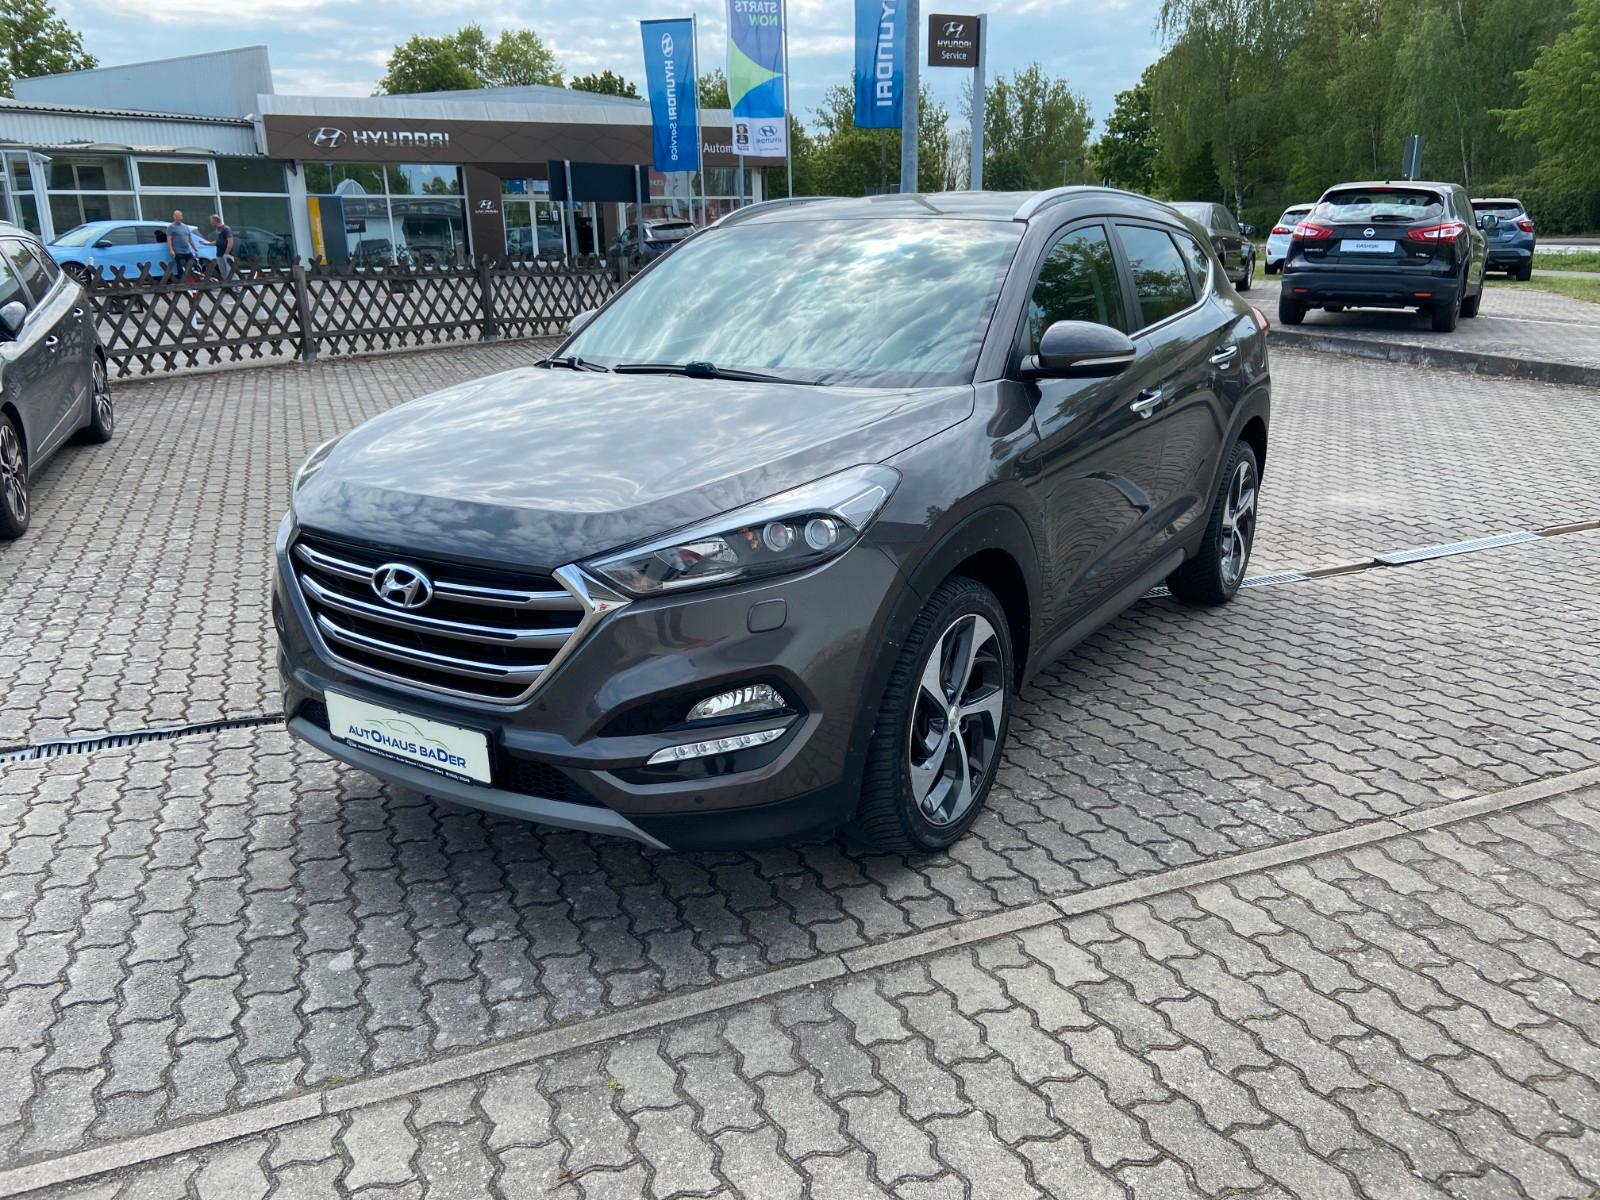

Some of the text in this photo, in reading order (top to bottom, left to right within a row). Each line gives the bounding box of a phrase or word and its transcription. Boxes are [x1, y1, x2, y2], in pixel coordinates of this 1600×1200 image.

[937, 39, 972, 48] HYUNDAI
[941, 50, 967, 60] Service
[352, 130, 450, 147] HYUNDAI
[349, 725, 417, 754] AUTOHAUS
[420, 745, 467, 769] BADER
